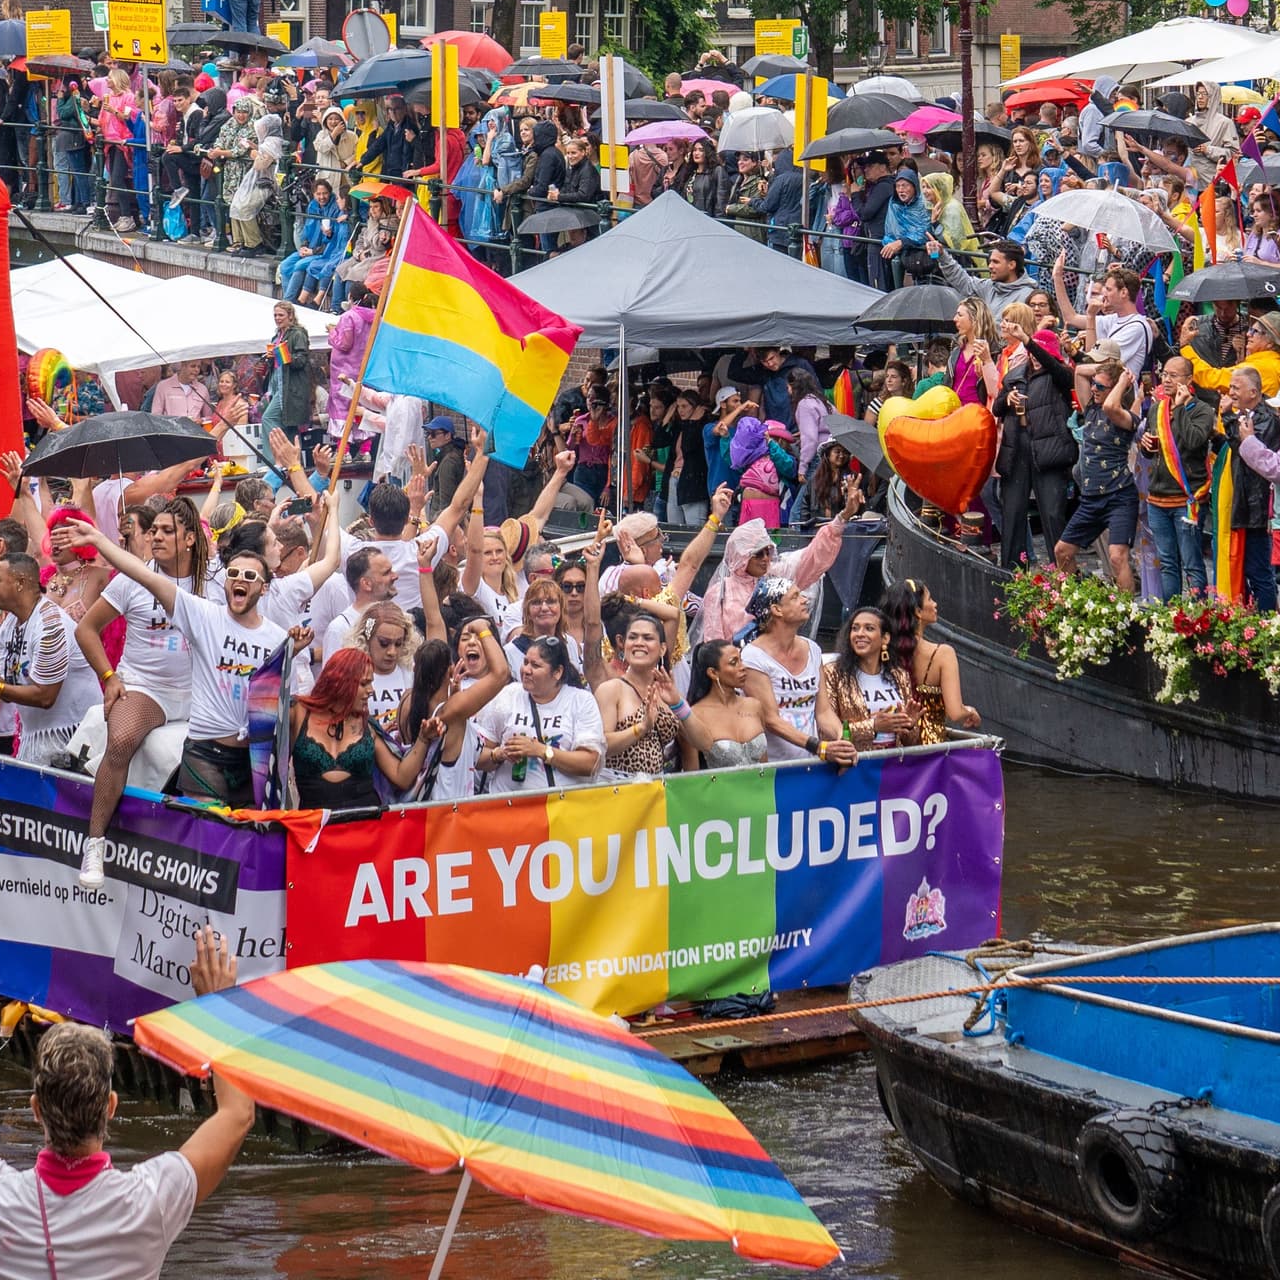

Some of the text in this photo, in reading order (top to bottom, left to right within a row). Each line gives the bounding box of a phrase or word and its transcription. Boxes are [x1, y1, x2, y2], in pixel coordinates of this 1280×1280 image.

[370, 687, 404, 702] HAT
[514, 713, 562, 729] HTE
[103, 838, 154, 875] DRAG
[156, 854, 221, 895] SHOWS
[344, 792, 950, 928] ARE YOU INCLUDED?
[53, 885, 70, 905] op
[72, 887, 115, 907] Pride-
[585, 946, 698, 981] FOUNDATION
[703, 941, 737, 965] FOR
[739, 927, 814, 959] EQUALITY
